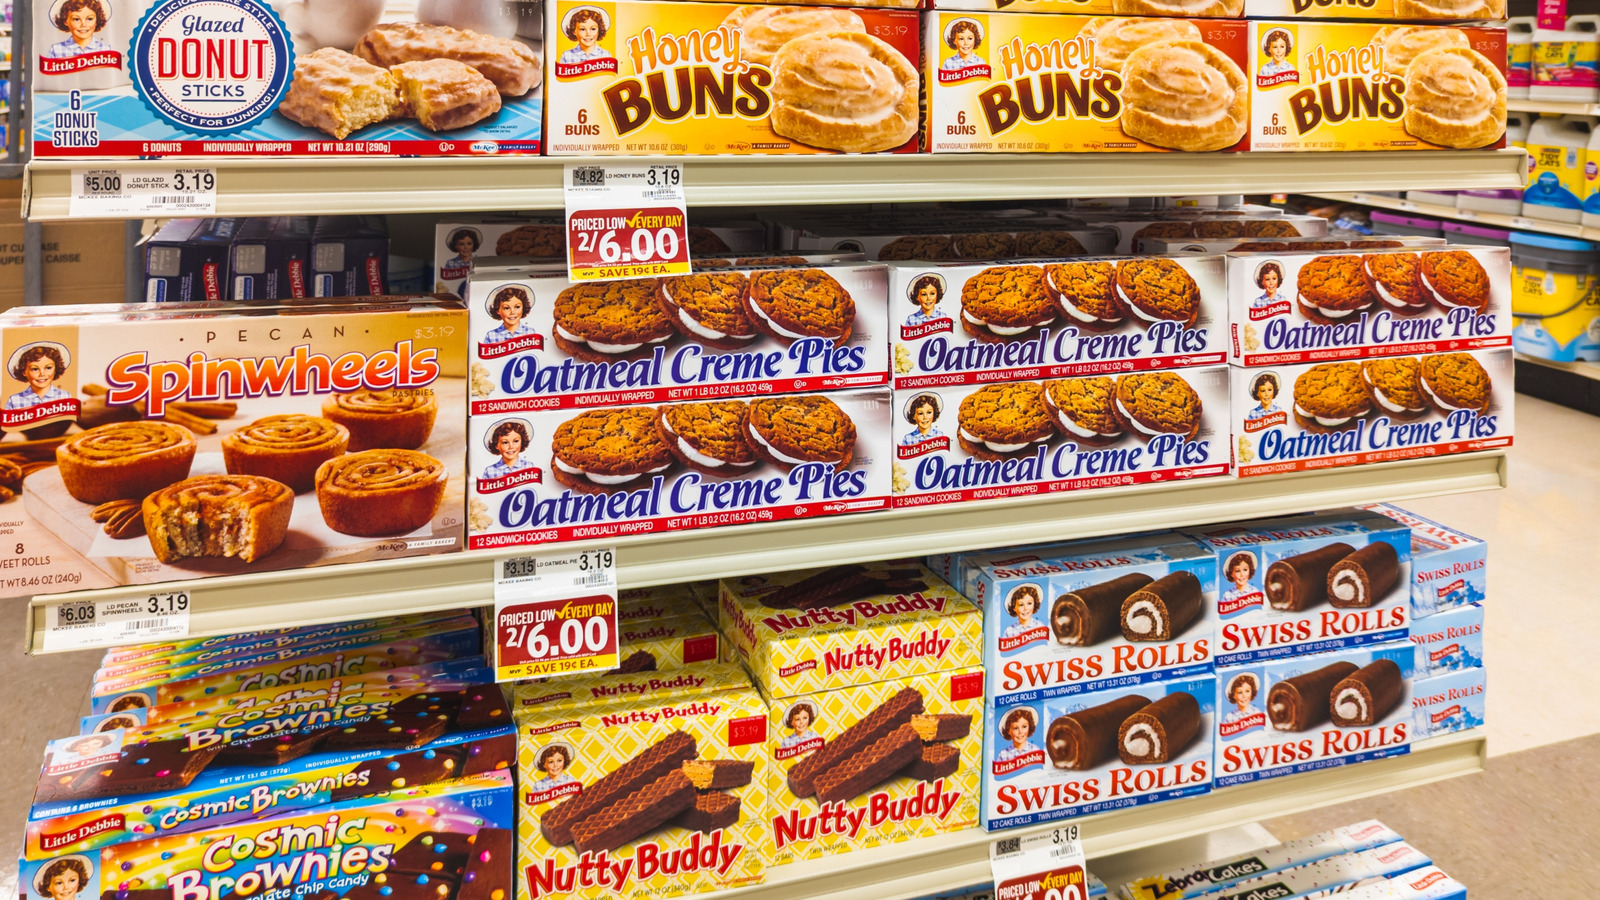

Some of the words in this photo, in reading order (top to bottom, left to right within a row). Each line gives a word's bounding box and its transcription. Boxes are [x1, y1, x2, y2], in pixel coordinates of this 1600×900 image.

[181, 15, 244, 36] Glazed
[873, 25, 908, 37] $3.19
[630, 26, 748, 73] Honey
[1475, 41, 1499, 52] $3.19
[43, 60, 75, 72] Little
[76, 55, 118, 70] Debbie
[157, 38, 270, 80] DONUT
[1001, 36, 1102, 79] Honey
[1306, 44, 1389, 83] Honey
[558, 64, 582, 76] Little
[584, 61, 615, 74] Debbie
[181, 84, 244, 97] STICKS
[70, 90, 81, 111] 6
[151, 91, 198, 126] PERFECT
[199, 117, 226, 127] FOR
[227, 92, 274, 126] DUNKING!
[603, 66, 773, 136] BUNS
[979, 73, 1122, 136] BUNS
[1289, 77, 1405, 136] BUNS
[55, 112, 97, 129] DONUT
[577, 108, 588, 125] 6
[53, 130, 99, 148] STICKS
[564, 124, 600, 136] BUNS
[143, 143, 149, 153] 6
[151, 143, 182, 153] DONUTS
[203, 143, 254, 153] INDIVIDUALLY
[255, 143, 292, 153] WRAPPED
[308, 143, 321, 153] NET
[323, 143, 334, 153] WT
[336, 143, 353, 153] 10.21
[355, 143, 365, 153] OZ
[471, 143, 498, 153] McKee
[552, 143, 593, 152] INDIVIDUALLY
[593, 143, 620, 152] WRAPPED
[1538, 160, 1560, 168] CATS
[86, 176, 121, 191] $5.00
[174, 173, 214, 190] 3.19
[575, 171, 603, 184] $4.82
[647, 169, 680, 185] 3.19
[571, 217, 604, 231] PRICED
[606, 216, 627, 230] LOW
[636, 215, 664, 229] EVERY
[667, 214, 683, 228] DAY
[578, 227, 679, 263] 2/6.00
[45, 253, 81, 263] CAISSE
[599, 268, 630, 278] SAVE
[633, 267, 649, 277] 19¢
[652, 266, 671, 275] EA.
[206, 325, 345, 343] PECAN
[415, 326, 455, 339] $3.19
[1263, 312, 1368, 351] Oatmeal
[1370, 311, 1443, 343] Creme
[1448, 306, 1496, 337] Pies
[481, 344, 506, 356] Little
[507, 337, 540, 352] Debbie
[918, 329, 1048, 373] Oatmeal
[1053, 328, 1141, 364] Creme
[1147, 321, 1208, 356] Pies
[501, 345, 664, 396] Oatmeal
[671, 343, 783, 387] Creme
[789, 337, 866, 374] Pies
[106, 339, 441, 418] Spinwheels
[393, 388, 435, 398] PASTRIES
[575, 393, 620, 405] INDIVIDUALLY
[620, 391, 655, 402] WRAPPED
[668, 389, 681, 398] NET
[682, 388, 692, 397] WT
[699, 387, 708, 396] LB
[709, 386, 718, 395] 0.2
[720, 386, 729, 394] OZ
[745, 383, 757, 393] OZ)
[758, 383, 773, 393] 459g
[2, 411, 34, 424] Little
[35, 402, 77, 419] Debbie
[478, 403, 487, 412] 12
[488, 400, 526, 411] SANDWICH
[527, 397, 561, 408] COOKIES
[499, 475, 663, 528] Oatmeal
[670, 473, 783, 515] Creme
[789, 463, 866, 501] Pies
[15, 543, 24, 555] 8
[22, 556, 51, 567] ROLLS
[506, 560, 534, 575] $3.15
[579, 551, 612, 571] 3.19
[6, 578, 20, 588] WT
[20, 576, 40, 587] 8.46
[42, 576, 54, 586] OZ
[55, 572, 82, 585] (240g)
[1417, 567, 1451, 584] SWISS
[1453, 558, 1485, 575] ROLLS
[102, 607, 143, 616] SPINWHEELS
[148, 594, 189, 613] 3.19
[60, 605, 95, 622] $6.03
[500, 611, 533, 627] PRICED
[536, 608, 556, 622] LOW
[566, 603, 593, 619] EVERY
[595, 601, 614, 616] DAY
[506, 616, 608, 658] 2/6.00
[1000, 638, 1020, 651] Little
[1021, 629, 1047, 645] Debbie
[824, 643, 889, 677] Nutty
[888, 629, 951, 662] Buddy
[240, 655, 366, 693] Cosmic
[526, 662, 557, 675] SAVE
[559, 661, 577, 672] 19¢
[580, 659, 598, 669] EA.
[1003, 655, 1103, 690] SWISS
[1112, 640, 1209, 675] ROLLS
[998, 697, 1004, 705] 12
[1004, 694, 1019, 704] CAKE
[1020, 691, 1037, 702] ROLLS
[1043, 689, 1056, 698] TWIN
[1057, 685, 1082, 696] WRAPPED
[1412, 693, 1446, 709] SWISS
[1448, 684, 1483, 702] ROLLS
[216, 690, 364, 728] Cosmic
[600, 711, 660, 728] Nutty
[662, 702, 721, 720] Buddy
[183, 702, 393, 752] Brownies
[733, 724, 759, 738] $3.19
[1222, 739, 1313, 772] SWISS
[1320, 722, 1406, 757] ROLLS
[305, 755, 349, 769] INDIVIDUALLY
[349, 751, 382, 762] WRAPPED
[160, 795, 251, 829] Cosmic
[251, 770, 371, 815] Brownies
[528, 791, 550, 804] Little
[551, 784, 580, 799] Debbie
[772, 802, 866, 849] Nutty
[870, 779, 961, 827] Buddy
[44, 826, 77, 850] Little
[80, 818, 122, 838] Debbie
[1053, 825, 1078, 845] 3.19
[202, 815, 367, 873] Cosmic
[166, 844, 394, 900] Brownies
[525, 849, 634, 900] Nutty
[636, 829, 743, 880] Buddy
[296, 883, 325, 899] Chip
[329, 874, 370, 890] Candy
[1141, 869, 1209, 899] Zebra
[1208, 860, 1263, 882] Cakes
